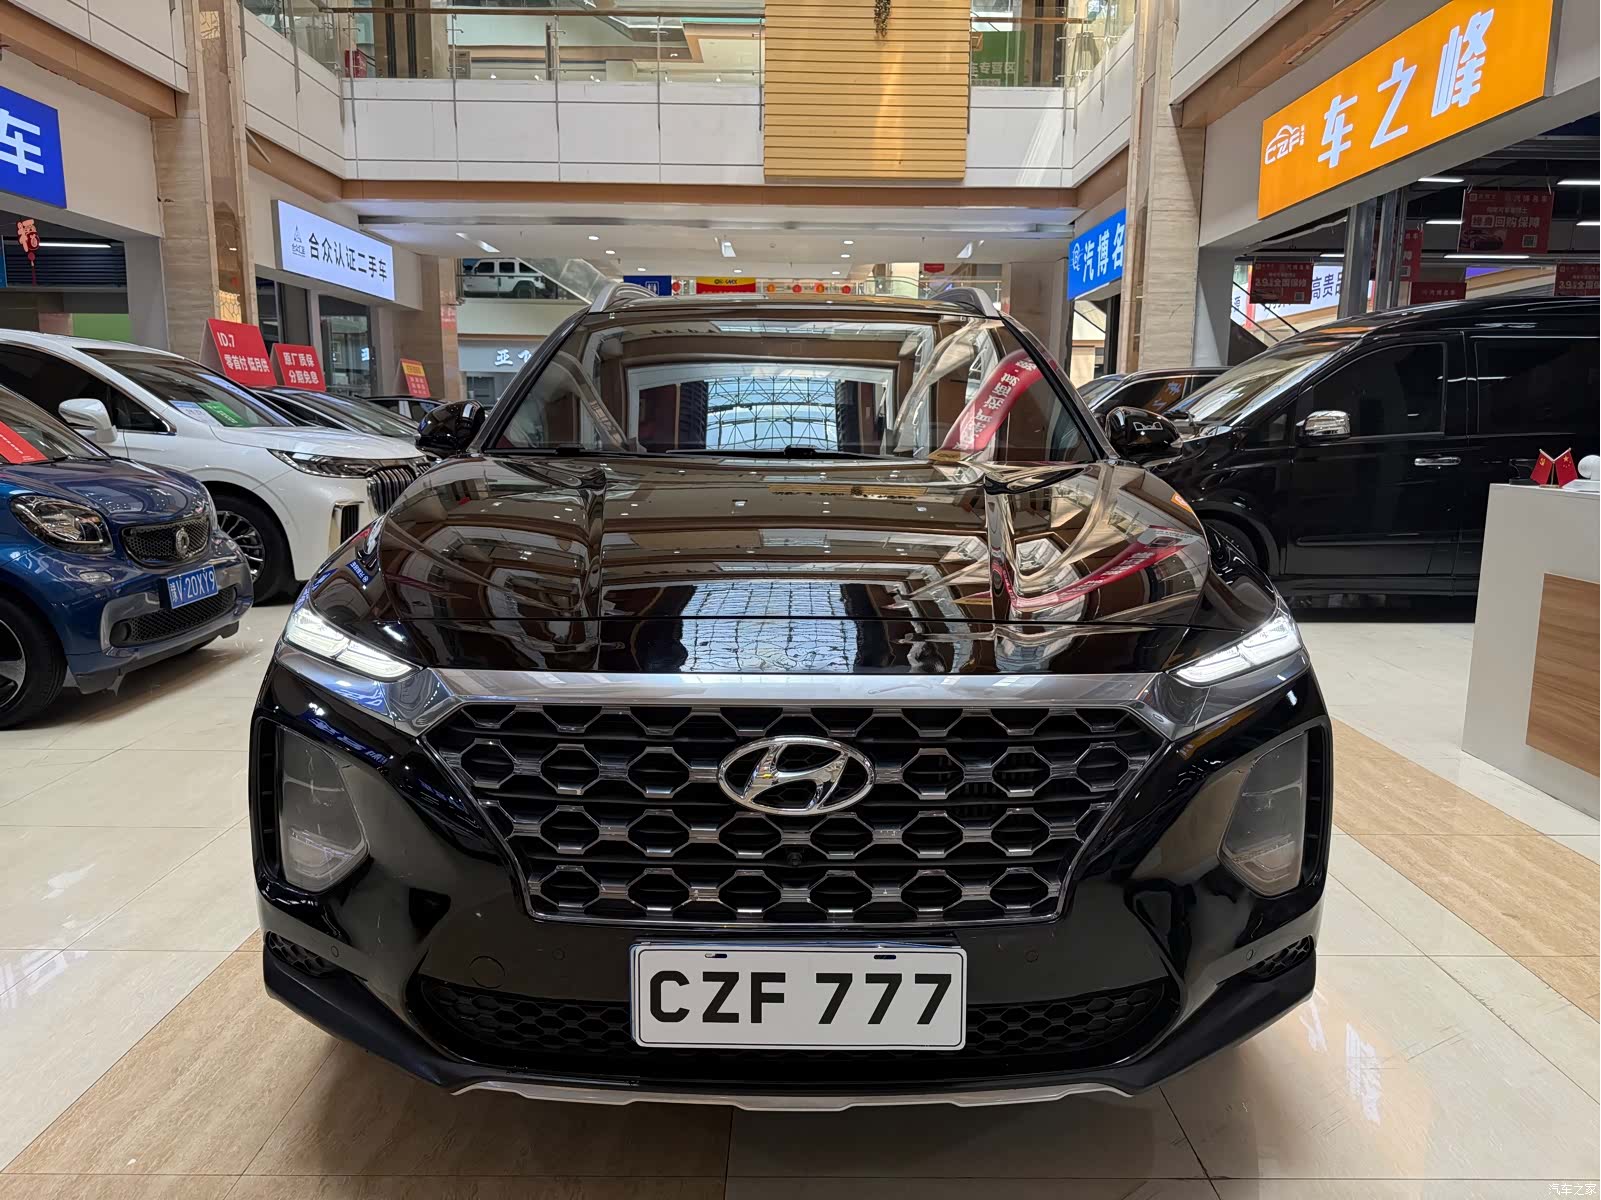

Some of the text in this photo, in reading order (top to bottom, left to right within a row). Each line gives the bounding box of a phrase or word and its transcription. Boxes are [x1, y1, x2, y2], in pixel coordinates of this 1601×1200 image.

[1317, 8, 1495, 169] 车之峰
[308, 232, 388, 283] 合众认证二手车
[217, 331, 235, 349] ID.7
[649, 970, 952, 1025] CZF 777
